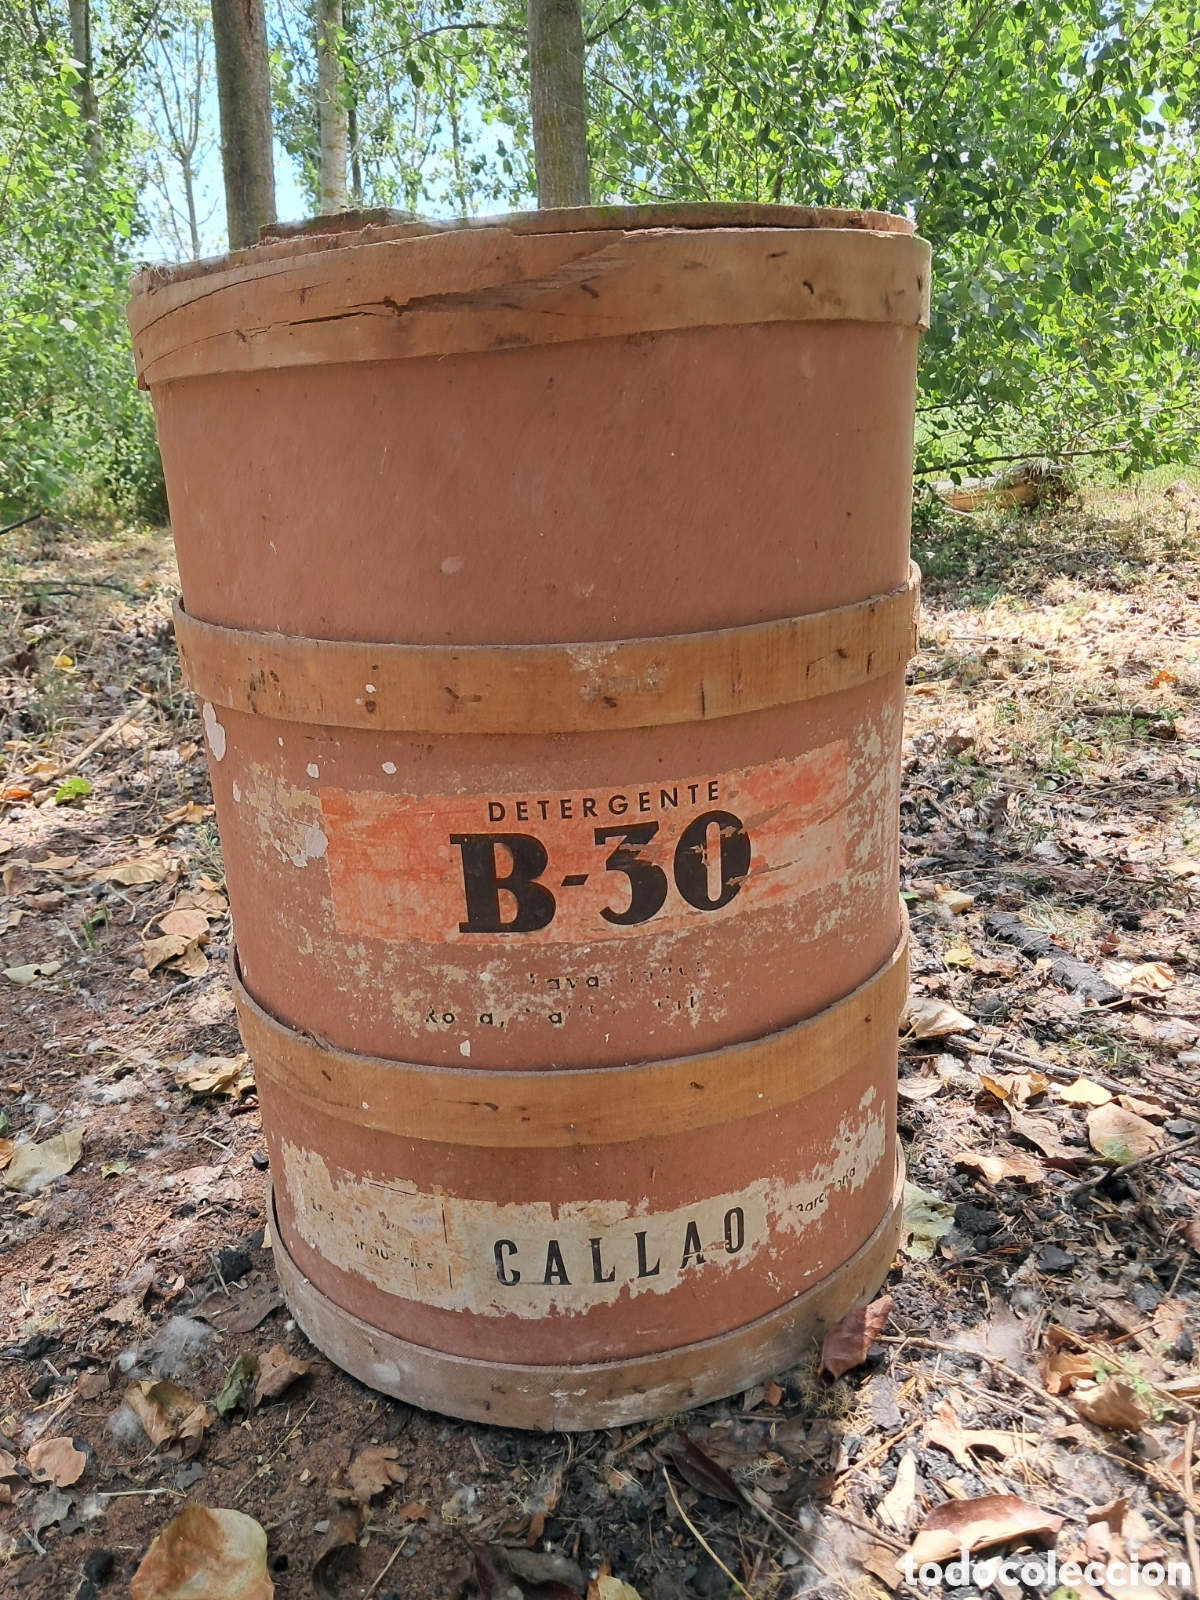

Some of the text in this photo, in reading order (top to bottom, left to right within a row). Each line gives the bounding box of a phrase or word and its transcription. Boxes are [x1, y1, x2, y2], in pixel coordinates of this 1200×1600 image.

[489, 780, 719, 822] DETERGENTE
[449, 809, 752, 934] B-30
[494, 1206, 745, 1287] CALLAO
